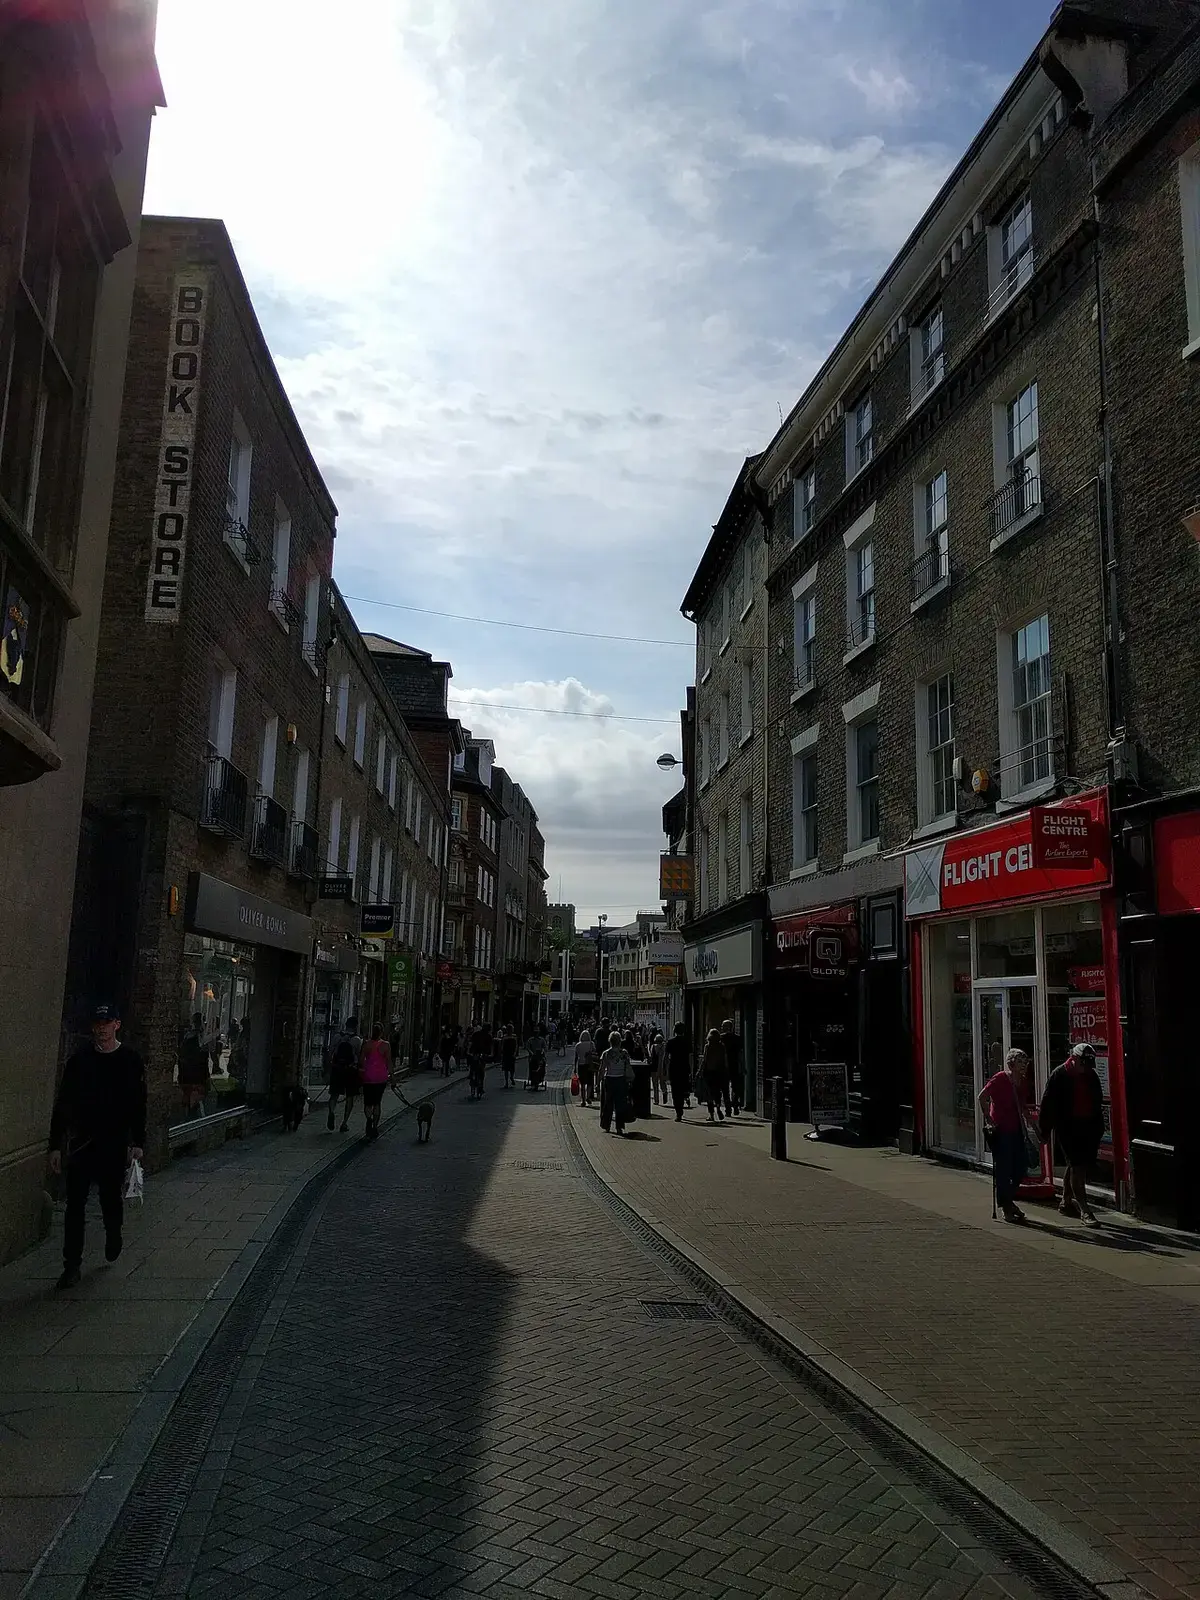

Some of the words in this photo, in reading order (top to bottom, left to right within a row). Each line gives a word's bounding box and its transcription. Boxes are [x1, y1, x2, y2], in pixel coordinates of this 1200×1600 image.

[168, 286, 203, 414] BOOK
[151, 446, 189, 608] STORE
[1043, 815, 1086, 825] FLIGHT
[1042, 826, 1088, 836] CENTRE
[944, 851, 1002, 887] FLIGHT
[1004, 843, 1034, 873] CE
[812, 967, 846, 976] SLOTS
[1073, 1013, 1096, 1028] RED
